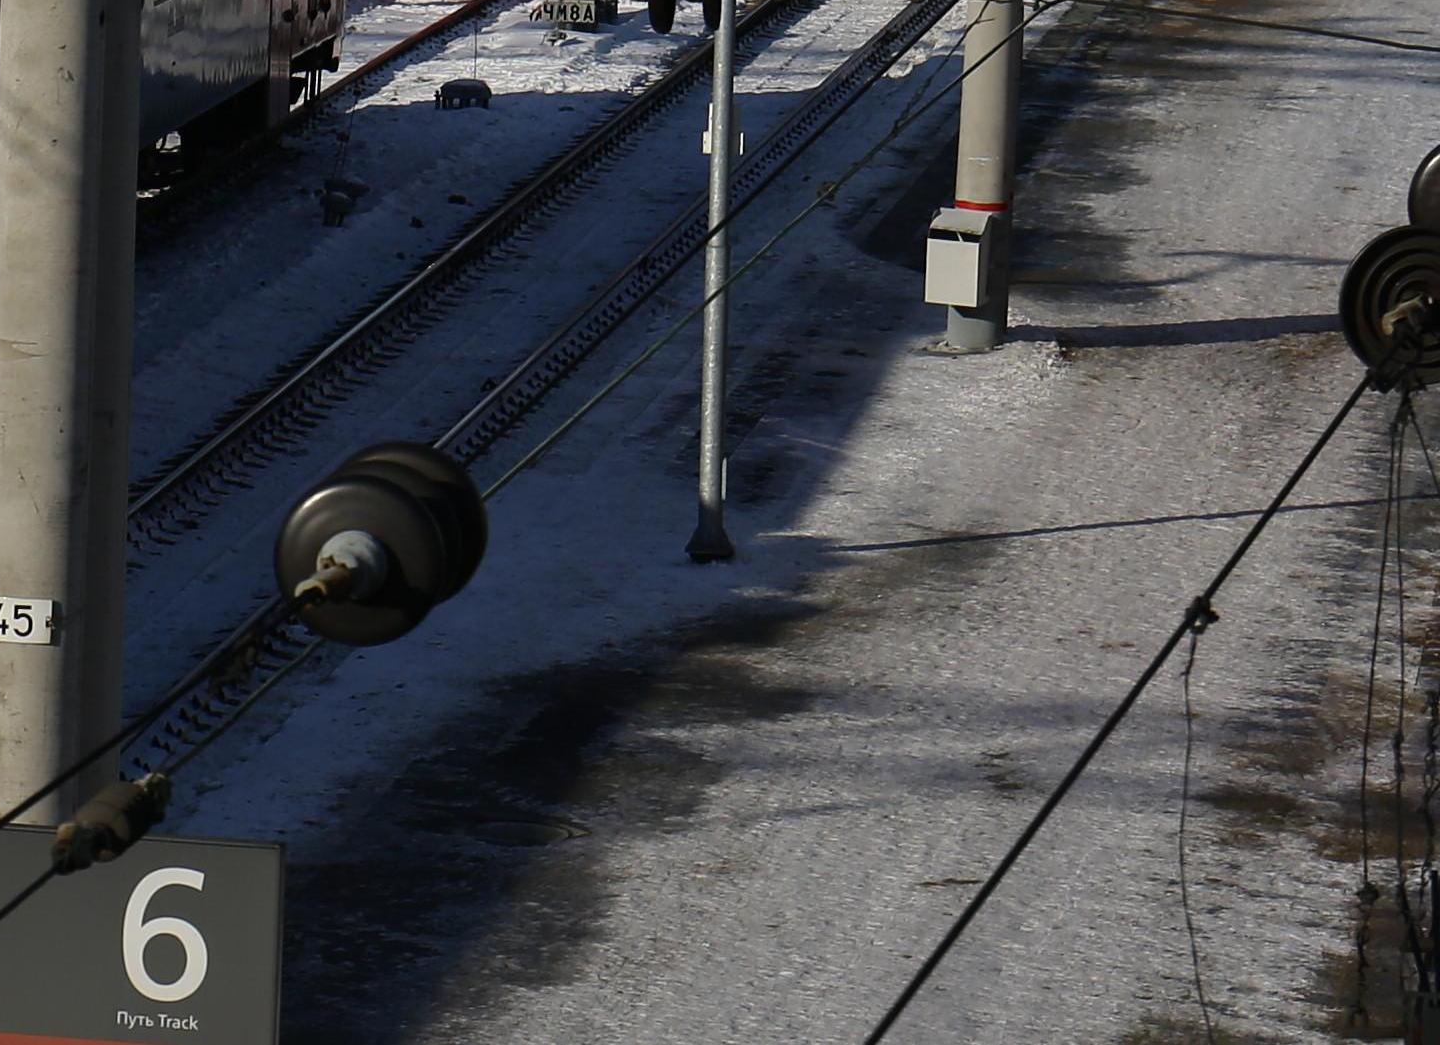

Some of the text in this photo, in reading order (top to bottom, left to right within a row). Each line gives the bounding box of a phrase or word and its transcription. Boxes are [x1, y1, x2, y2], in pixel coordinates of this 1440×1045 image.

[544, 3, 593, 21] ЧМ8А
[121, 866, 209, 1003] 6
[117, 1011, 199, 1031] Путь Track
